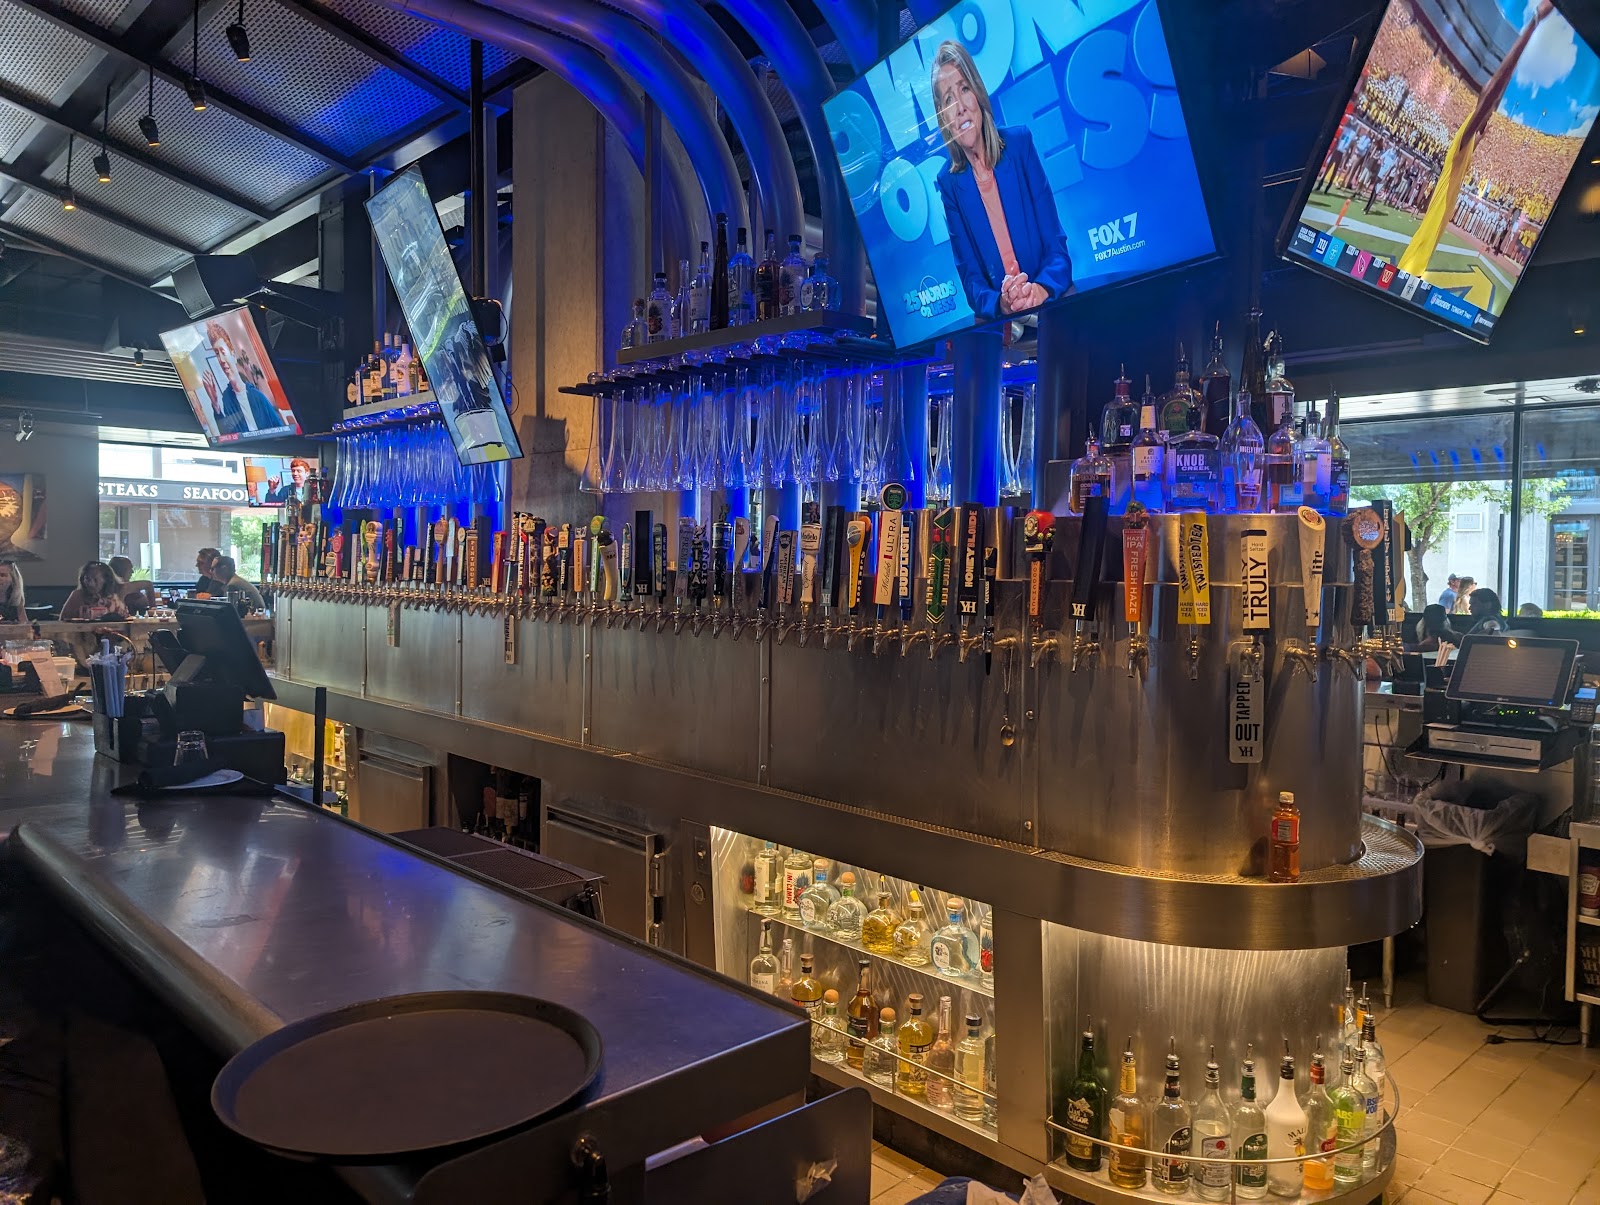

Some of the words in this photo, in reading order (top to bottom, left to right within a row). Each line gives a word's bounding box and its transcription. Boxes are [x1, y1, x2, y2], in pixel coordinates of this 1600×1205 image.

[1088, 218, 1126, 250] FOX
[1123, 211, 1138, 238] 7
[1094, 240, 1146, 262] FOX7Austin.com
[903, 289, 921, 314] 25
[918, 280, 957, 306] WORDS
[920, 305, 934, 318] OR
[1176, 454, 1205, 467] KNOB
[99, 481, 158, 498] STEAKS
[885, 517, 897, 553] ULTRA
[967, 510, 978, 547] BLONDE
[1189, 523, 1204, 543] TEA
[900, 526, 910, 566] LIGHT
[692, 548, 701, 585] IPA
[701, 547, 710, 585] STONE
[881, 561, 892, 597] Michelob
[899, 567, 909, 596] BUD
[964, 546, 976, 588] HONEY
[1130, 551, 1139, 585] FRESH
[1191, 545, 1208, 592] TWISTED
[1129, 588, 1138, 614] HAZE
[1241, 559, 1249, 621] TRULY
[1249, 557, 1268, 621] TRULY
[960, 600, 977, 613] YH
[1071, 602, 1086, 617] YH
[1236, 681, 1251, 722] TAPPED
[1235, 723, 1260, 742] OUT
[1238, 746, 1254, 757] YH
